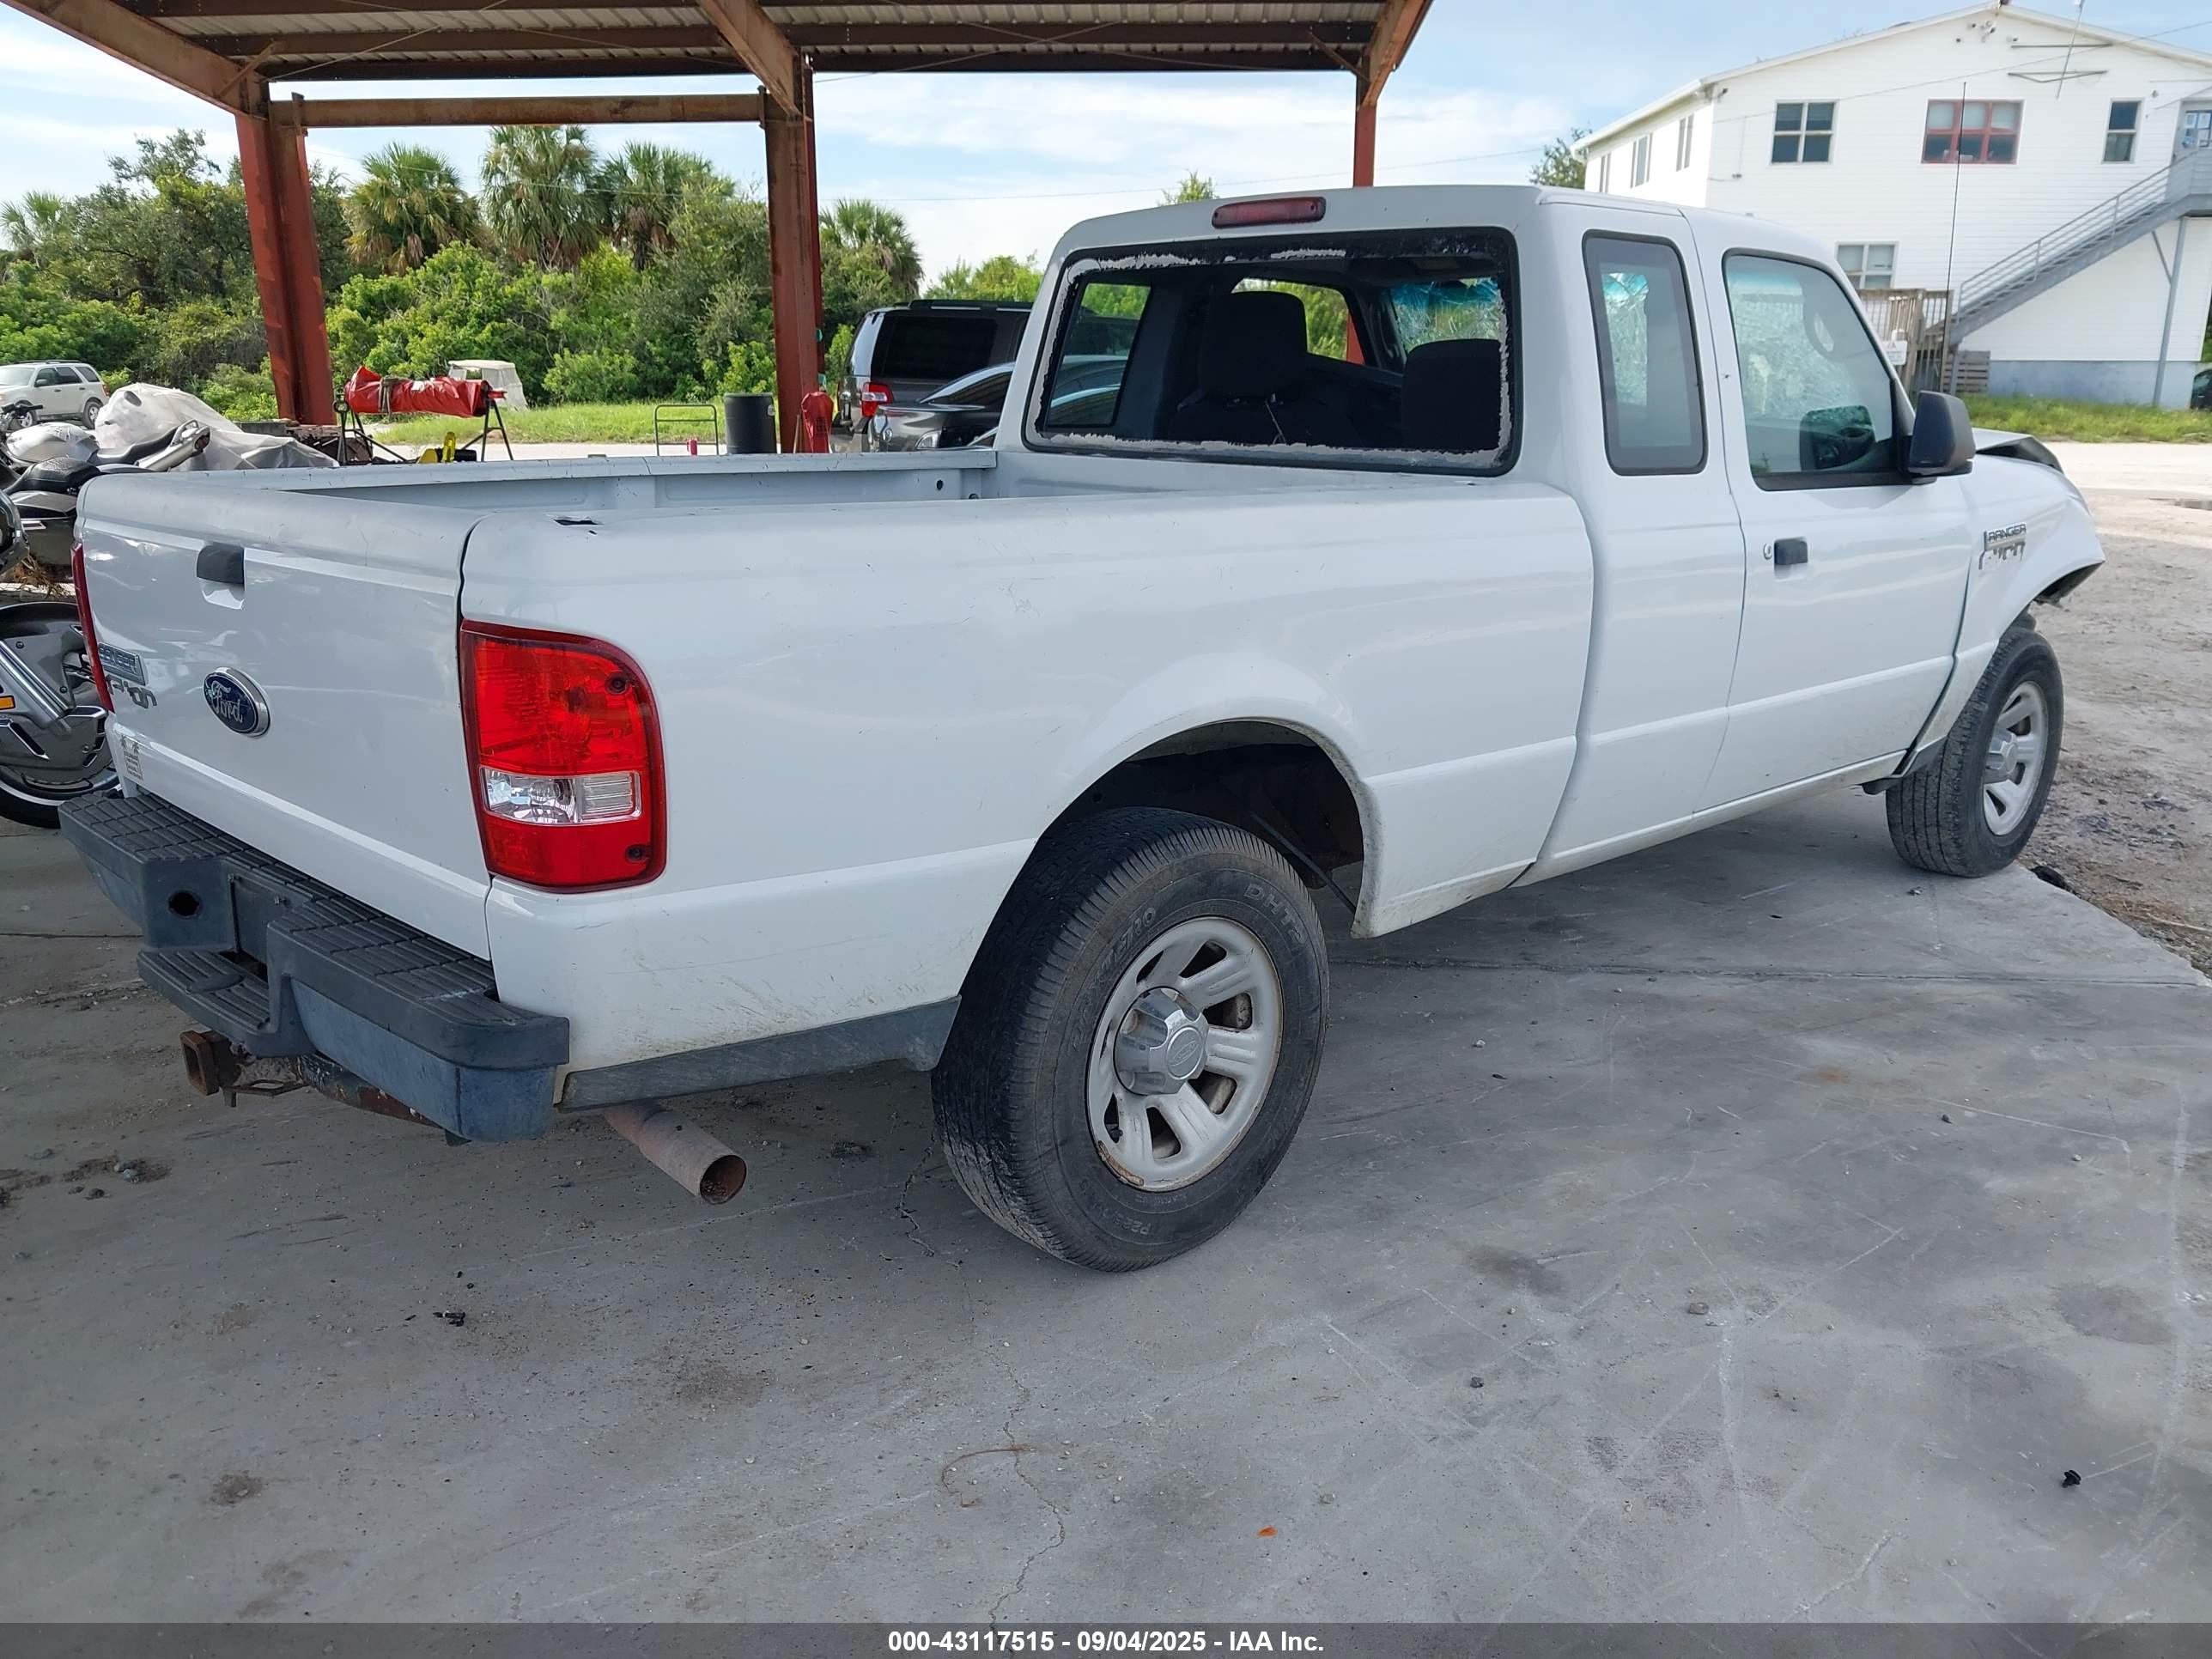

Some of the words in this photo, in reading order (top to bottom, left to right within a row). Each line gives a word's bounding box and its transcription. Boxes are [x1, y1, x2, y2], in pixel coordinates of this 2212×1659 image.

[1988, 523, 2027, 541] RANGER
[206, 680, 244, 723] Ford
[1243, 883, 1306, 945] DHT2
